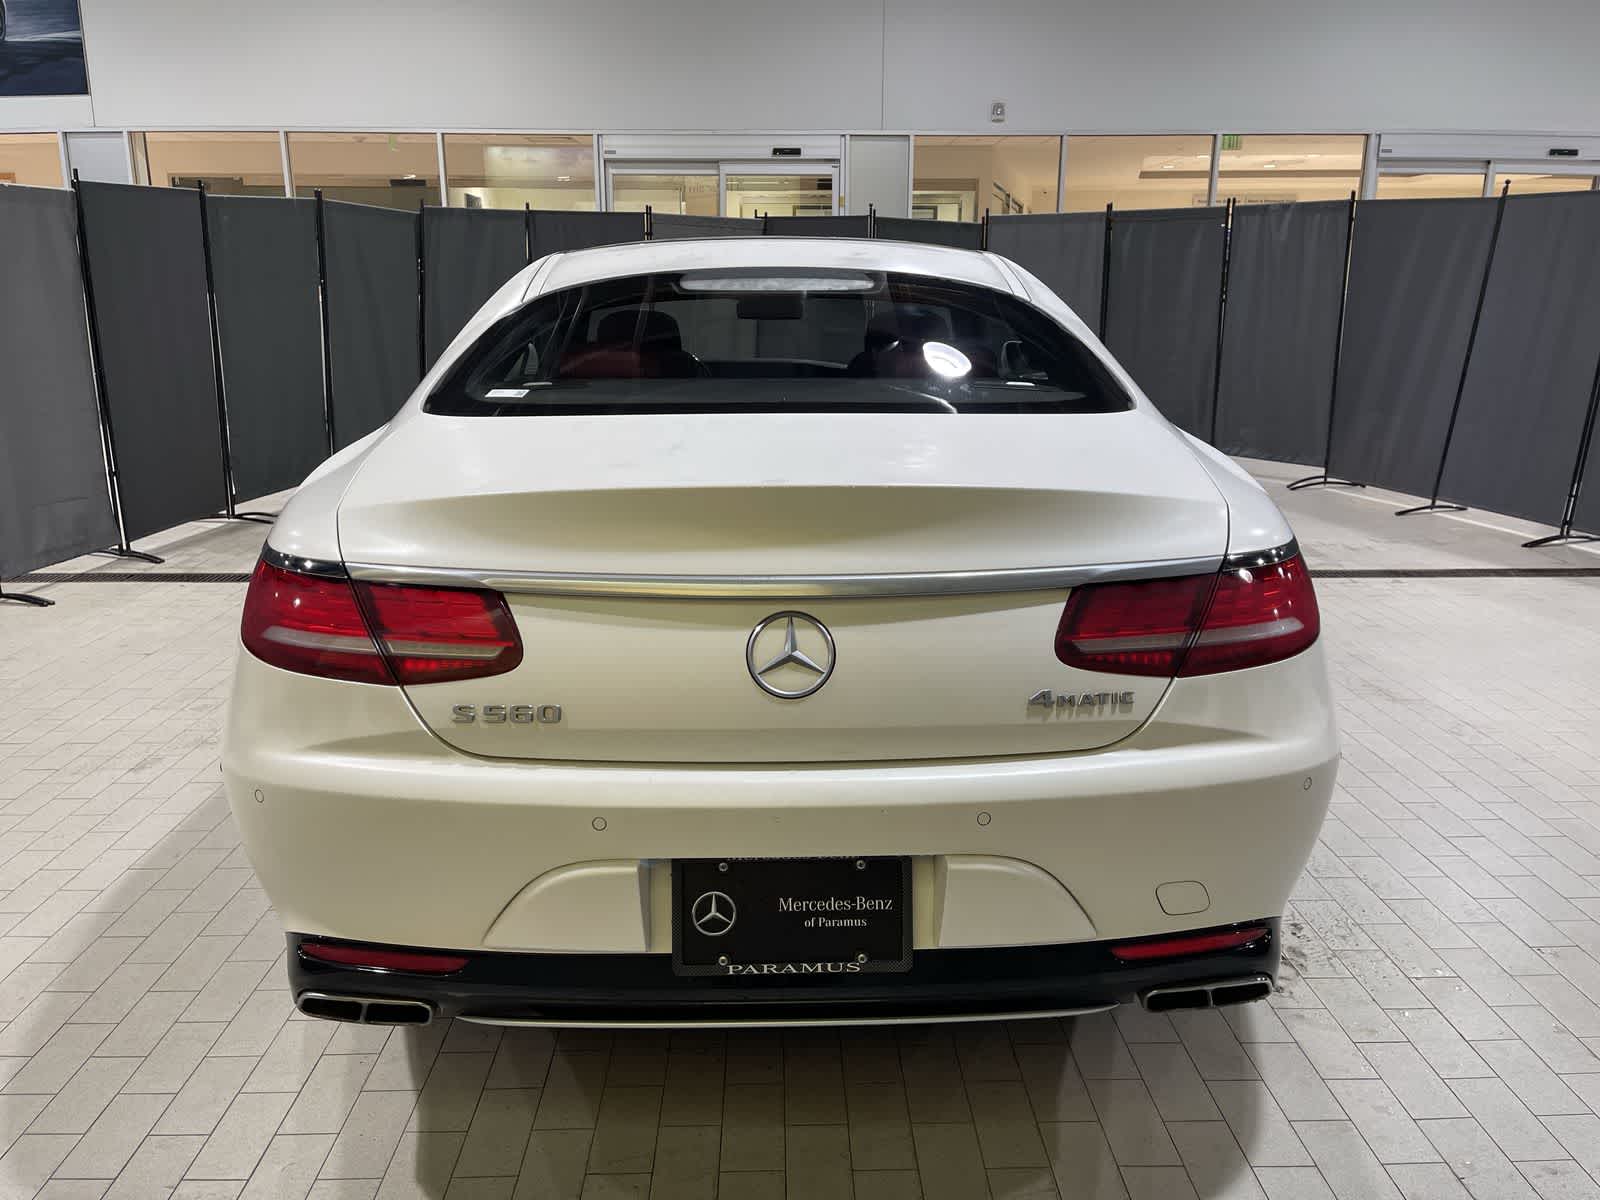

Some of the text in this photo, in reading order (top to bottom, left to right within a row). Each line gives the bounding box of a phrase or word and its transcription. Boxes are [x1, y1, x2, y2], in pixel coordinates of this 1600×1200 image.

[1028, 689, 1135, 708] 4MATIC
[452, 704, 562, 723] S 560
[778, 896, 893, 912] Mercedes-Benz
[804, 917, 867, 928] of Paramus
[728, 962, 861, 975] PARAMUS
